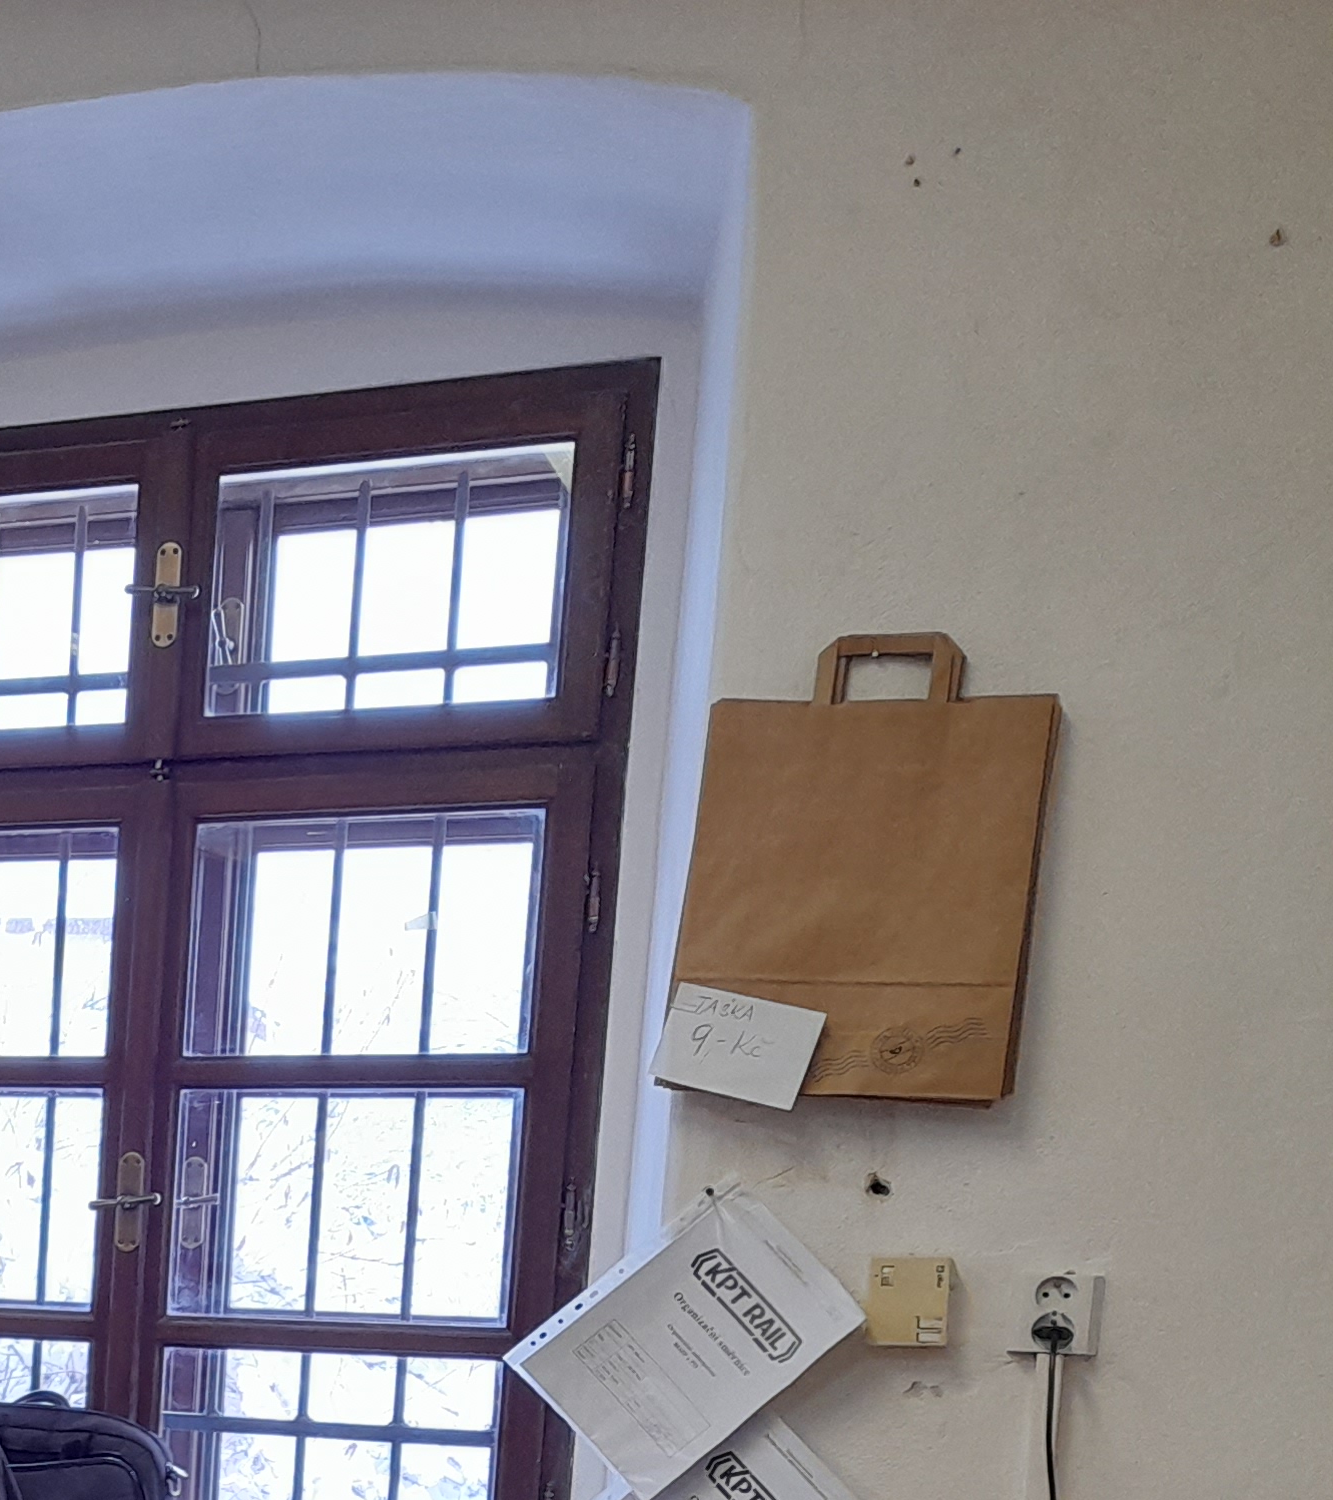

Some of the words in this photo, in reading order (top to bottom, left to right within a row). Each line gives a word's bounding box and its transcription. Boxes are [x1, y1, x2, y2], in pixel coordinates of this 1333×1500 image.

[730, 1030, 775, 1058] Kč
[704, 1261, 753, 1305] KPT
[742, 1302, 787, 1351] RAIL
